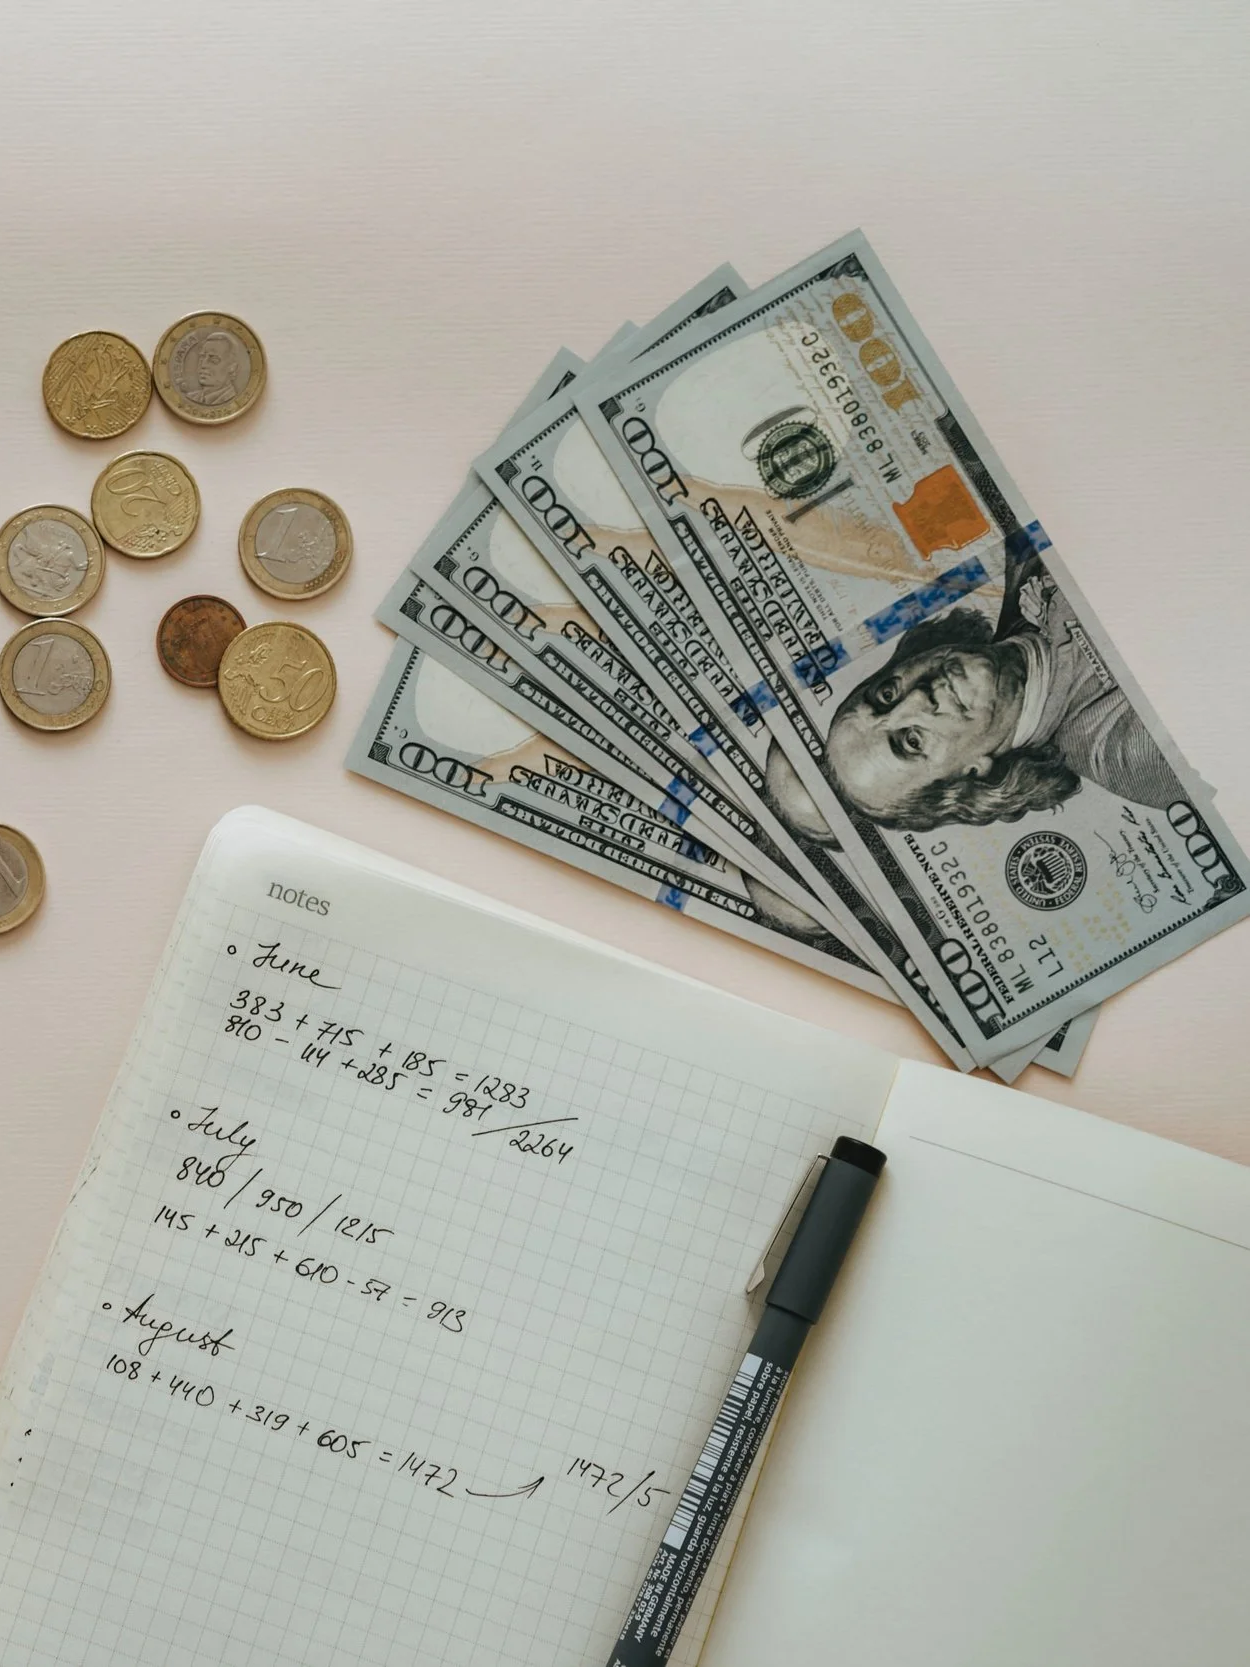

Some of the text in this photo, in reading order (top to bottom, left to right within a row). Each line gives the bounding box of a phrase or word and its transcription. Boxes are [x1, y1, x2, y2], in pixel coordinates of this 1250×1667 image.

[824, 286, 923, 416] 100
[798, 329, 903, 484] ML 83801932 C
[616, 411, 690, 509] 100
[516, 468, 599, 564] 100
[696, 494, 775, 605] STATES
[456, 560, 549, 645] 100
[606, 542, 692, 645] STATES
[727, 505, 819, 638] AMERICA
[424, 601, 516, 678] 100
[671, 517, 826, 758] ONE HUNDRED DOLLARS
[759, 596, 837, 706] UNITED
[1071, 628, 1109, 679] FRANKLIN
[394, 737, 495, 801] 100
[505, 762, 621, 826] STATES
[498, 798, 757, 920] ONE HUNDRED DOLLARS
[927, 838, 950, 859] C
[1161, 793, 1235, 891] 100
[267, 880, 331, 918] notes
[901, 831, 1016, 1006] FEDERAL RESERVE NOTE
[938, 854, 1017, 965] 83801932
[252, 942, 342, 991] June
[932, 932, 1008, 1030] 100
[1005, 962, 1035, 995] ML
[1026, 932, 1065, 979] L12
[224, 1014, 262, 1042] 810
[442, 1091, 493, 1121] 981
[230, 989, 531, 1109] 383 715 185 1283
[187, 1106, 257, 1173] July
[508, 1129, 574, 1165] 2264
[176, 1156, 395, 1244] 840 950 1215
[153, 1205, 467, 1333] 145 215 610 57 913
[122, 1293, 236, 1357] August
[742, 1391, 760, 1420] papel,
[753, 1387, 775, 1424] lumière,
[757, 1362, 773, 1389] sobre
[772, 1376, 780, 1384] la
[106, 1354, 459, 1498] 108 440 319 605 1472
[721, 1424, 746, 1472] resistente
[734, 1428, 756, 1473] conserver
[703, 1495, 717, 1512] luz,
[712, 1484, 722, 1493] la
[721, 1482, 732, 1503] plat
[687, 1515, 706, 1551] guarda
[707, 1513, 721, 1535] tinta
[635, 1550, 668, 1620] Art. Nr. 308 03-9
[635, 1553, 676, 1642] MADE IN GERMANY
[651, 1553, 693, 1637] horizontalmente
[681, 1538, 709, 1594] documento,
[656, 1596, 684, 1656] permanente
